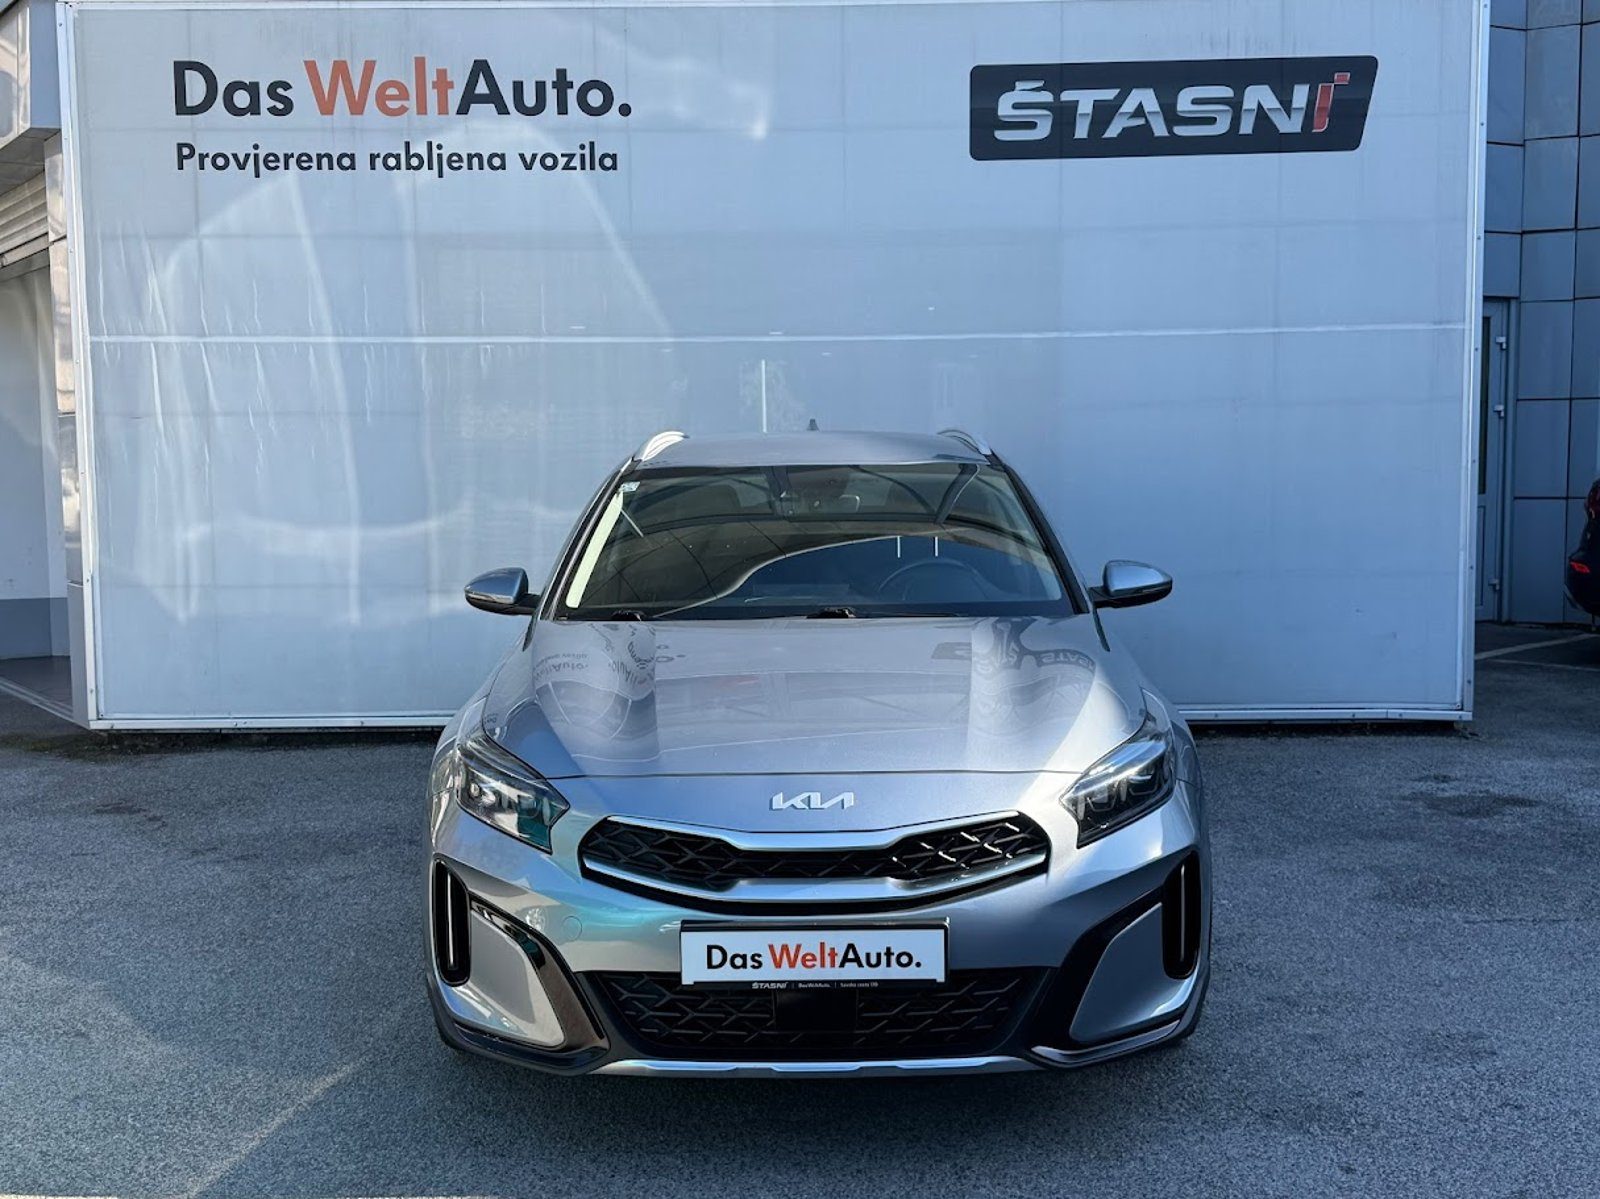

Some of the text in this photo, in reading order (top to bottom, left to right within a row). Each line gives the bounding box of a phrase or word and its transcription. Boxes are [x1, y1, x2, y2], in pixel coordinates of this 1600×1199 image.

[172, 56, 632, 117] Das WeltAuto.
[176, 140, 618, 178] Provjerena rabljena vozila
[770, 791, 854, 811] KIA
[706, 941, 922, 970] Das WeltAuto.
